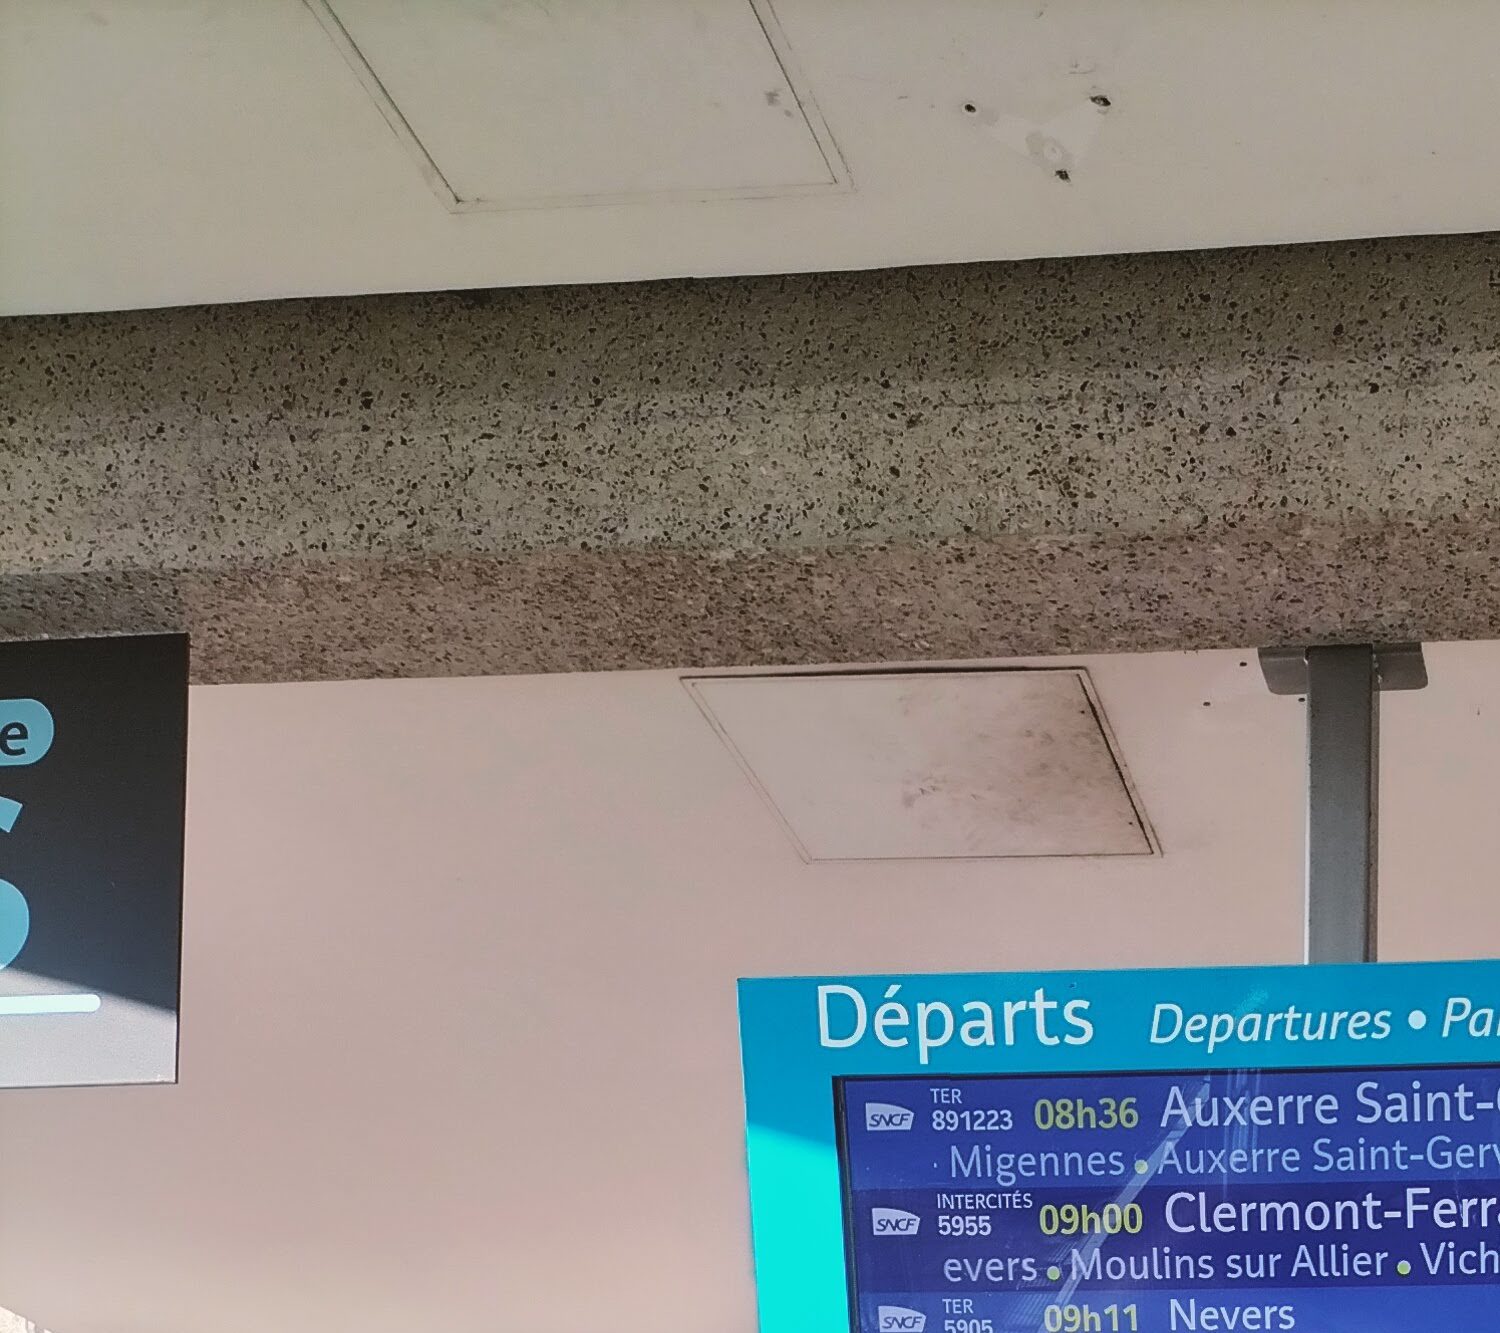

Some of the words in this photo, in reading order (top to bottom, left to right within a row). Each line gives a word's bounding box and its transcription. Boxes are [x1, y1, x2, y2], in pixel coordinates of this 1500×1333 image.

[817, 984, 1095, 1063] Départs
[1149, 1002, 1391, 1053] Departures
[868, 1111, 910, 1128] SNCF
[931, 1109, 1013, 1131] 891223
[1034, 1098, 1138, 1129] 08h36
[1160, 1085, 1340, 1127] Auxerre
[930, 1088, 962, 1104] TER
[950, 1144, 1125, 1186] Migennes
[1158, 1141, 1301, 1175] Auxerre
[936, 1190, 1033, 1210] INTERCITÉS
[875, 1217, 917, 1233] SNCF
[938, 1215, 992, 1237] 5955
[1039, 1203, 1143, 1235] 09h00
[1070, 1247, 1215, 1281] Moulins
[1226, 1250, 1282, 1280] sur
[1290, 1244, 1389, 1278] Allier
[882, 1314, 923, 1330] SNCF
[1043, 1303, 1139, 1333] 09h11
[1169, 1298, 1296, 1332] Nevers
[942, 1298, 973, 1314] TER
